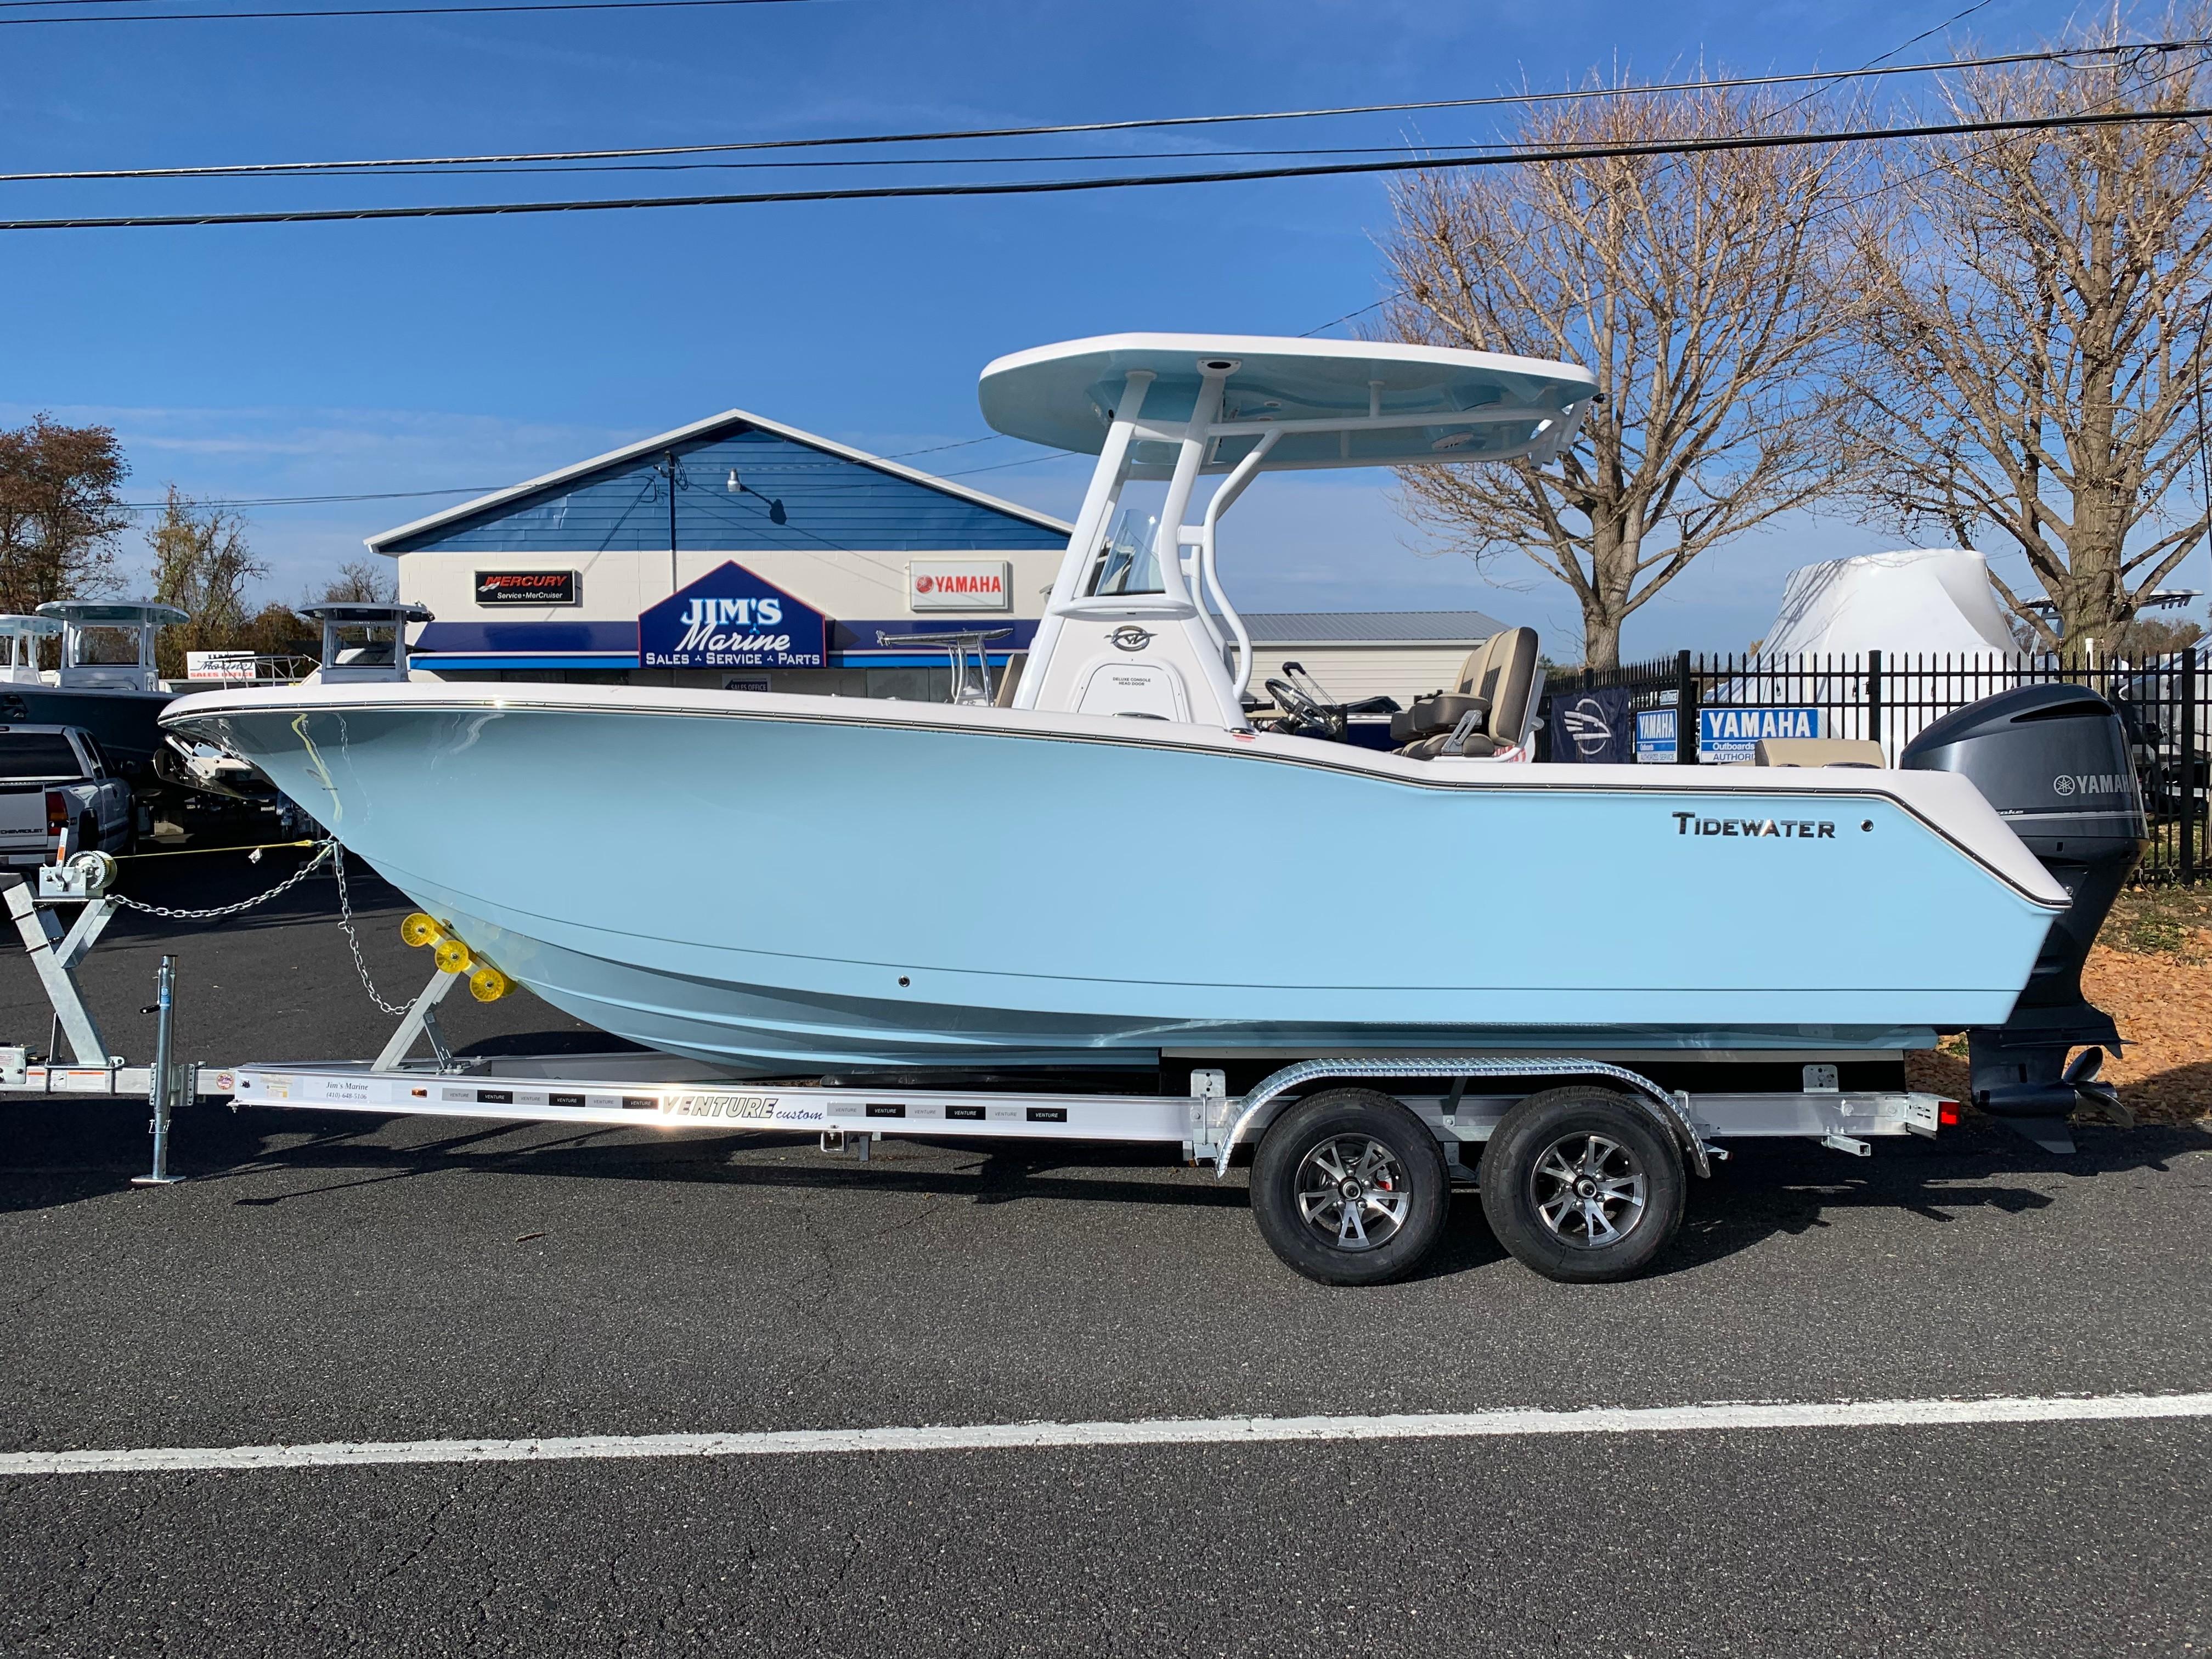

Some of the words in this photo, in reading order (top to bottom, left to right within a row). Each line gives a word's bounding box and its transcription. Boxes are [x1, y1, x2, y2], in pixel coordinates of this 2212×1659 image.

[486, 576, 567, 586] MERCURY
[935, 576, 1001, 592] YAMAHA
[680, 598, 783, 625] JIM'S
[674, 622, 791, 651] Marine
[646, 652, 690, 665] SALES
[706, 652, 763, 665] SERVICE
[778, 652, 820, 665] PARTS
[1639, 713, 1674, 740] YAMAHA
[1709, 712, 1811, 738] YAMAHA
[1713, 742, 1755, 751] Outboards
[663, 1096, 779, 1119] VENTURE
[776, 1109, 823, 1120] custom
